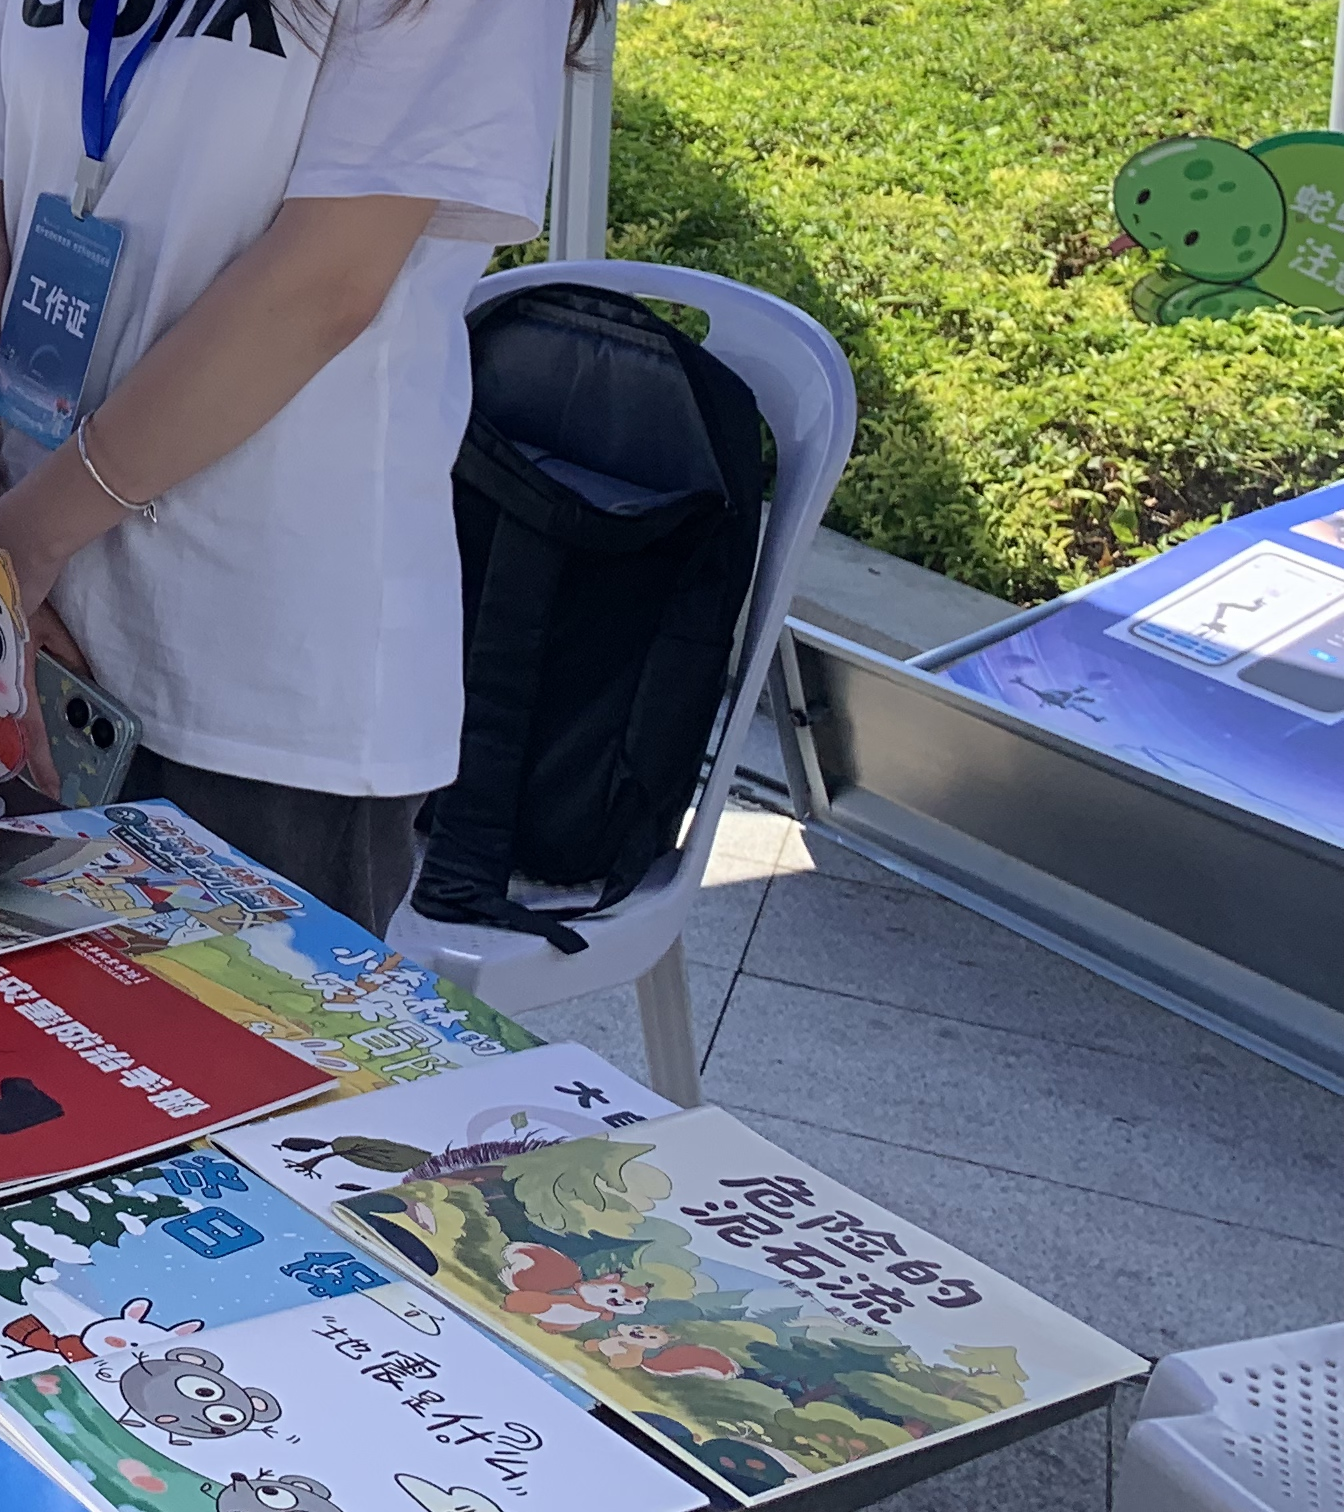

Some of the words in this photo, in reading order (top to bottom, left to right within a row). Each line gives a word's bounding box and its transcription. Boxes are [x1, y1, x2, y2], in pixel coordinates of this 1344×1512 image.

[22, 275, 90, 339] 工作证
[330, 946, 507, 1057] 小森林的
[680, 1197, 916, 1326] 泥石流
[719, 1174, 983, 1309] 危险的
